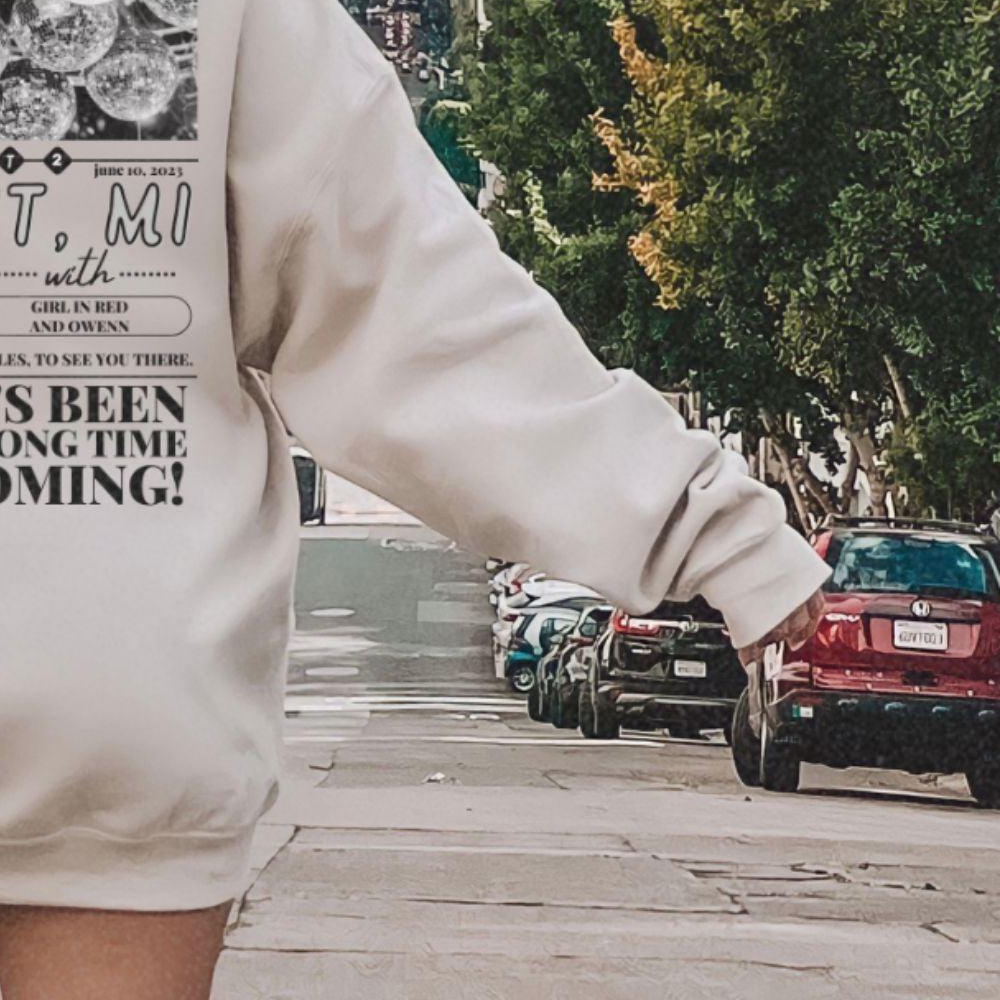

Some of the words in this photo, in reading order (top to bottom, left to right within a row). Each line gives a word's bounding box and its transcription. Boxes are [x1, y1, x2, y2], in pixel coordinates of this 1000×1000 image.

[94, 163, 124, 179] june
[127, 167, 146, 177] 10,
[150, 167, 183, 178] 2023
[104, 182, 192, 248] MI
[45, 247, 115, 287] with
[31, 300, 70, 314] GIRL
[74, 301, 90, 313] IN
[95, 300, 128, 314] RED
[30, 320, 65, 333] AND
[68, 320, 129, 333] OWENN
[34, 353, 59, 366] TO
[62, 353, 92, 366] SEE
[96, 353, 129, 367] YOU
[133, 353, 193, 367] THERE.
[48, 385, 188, 423] BEEN
[87, 430, 187, 458] TIME
